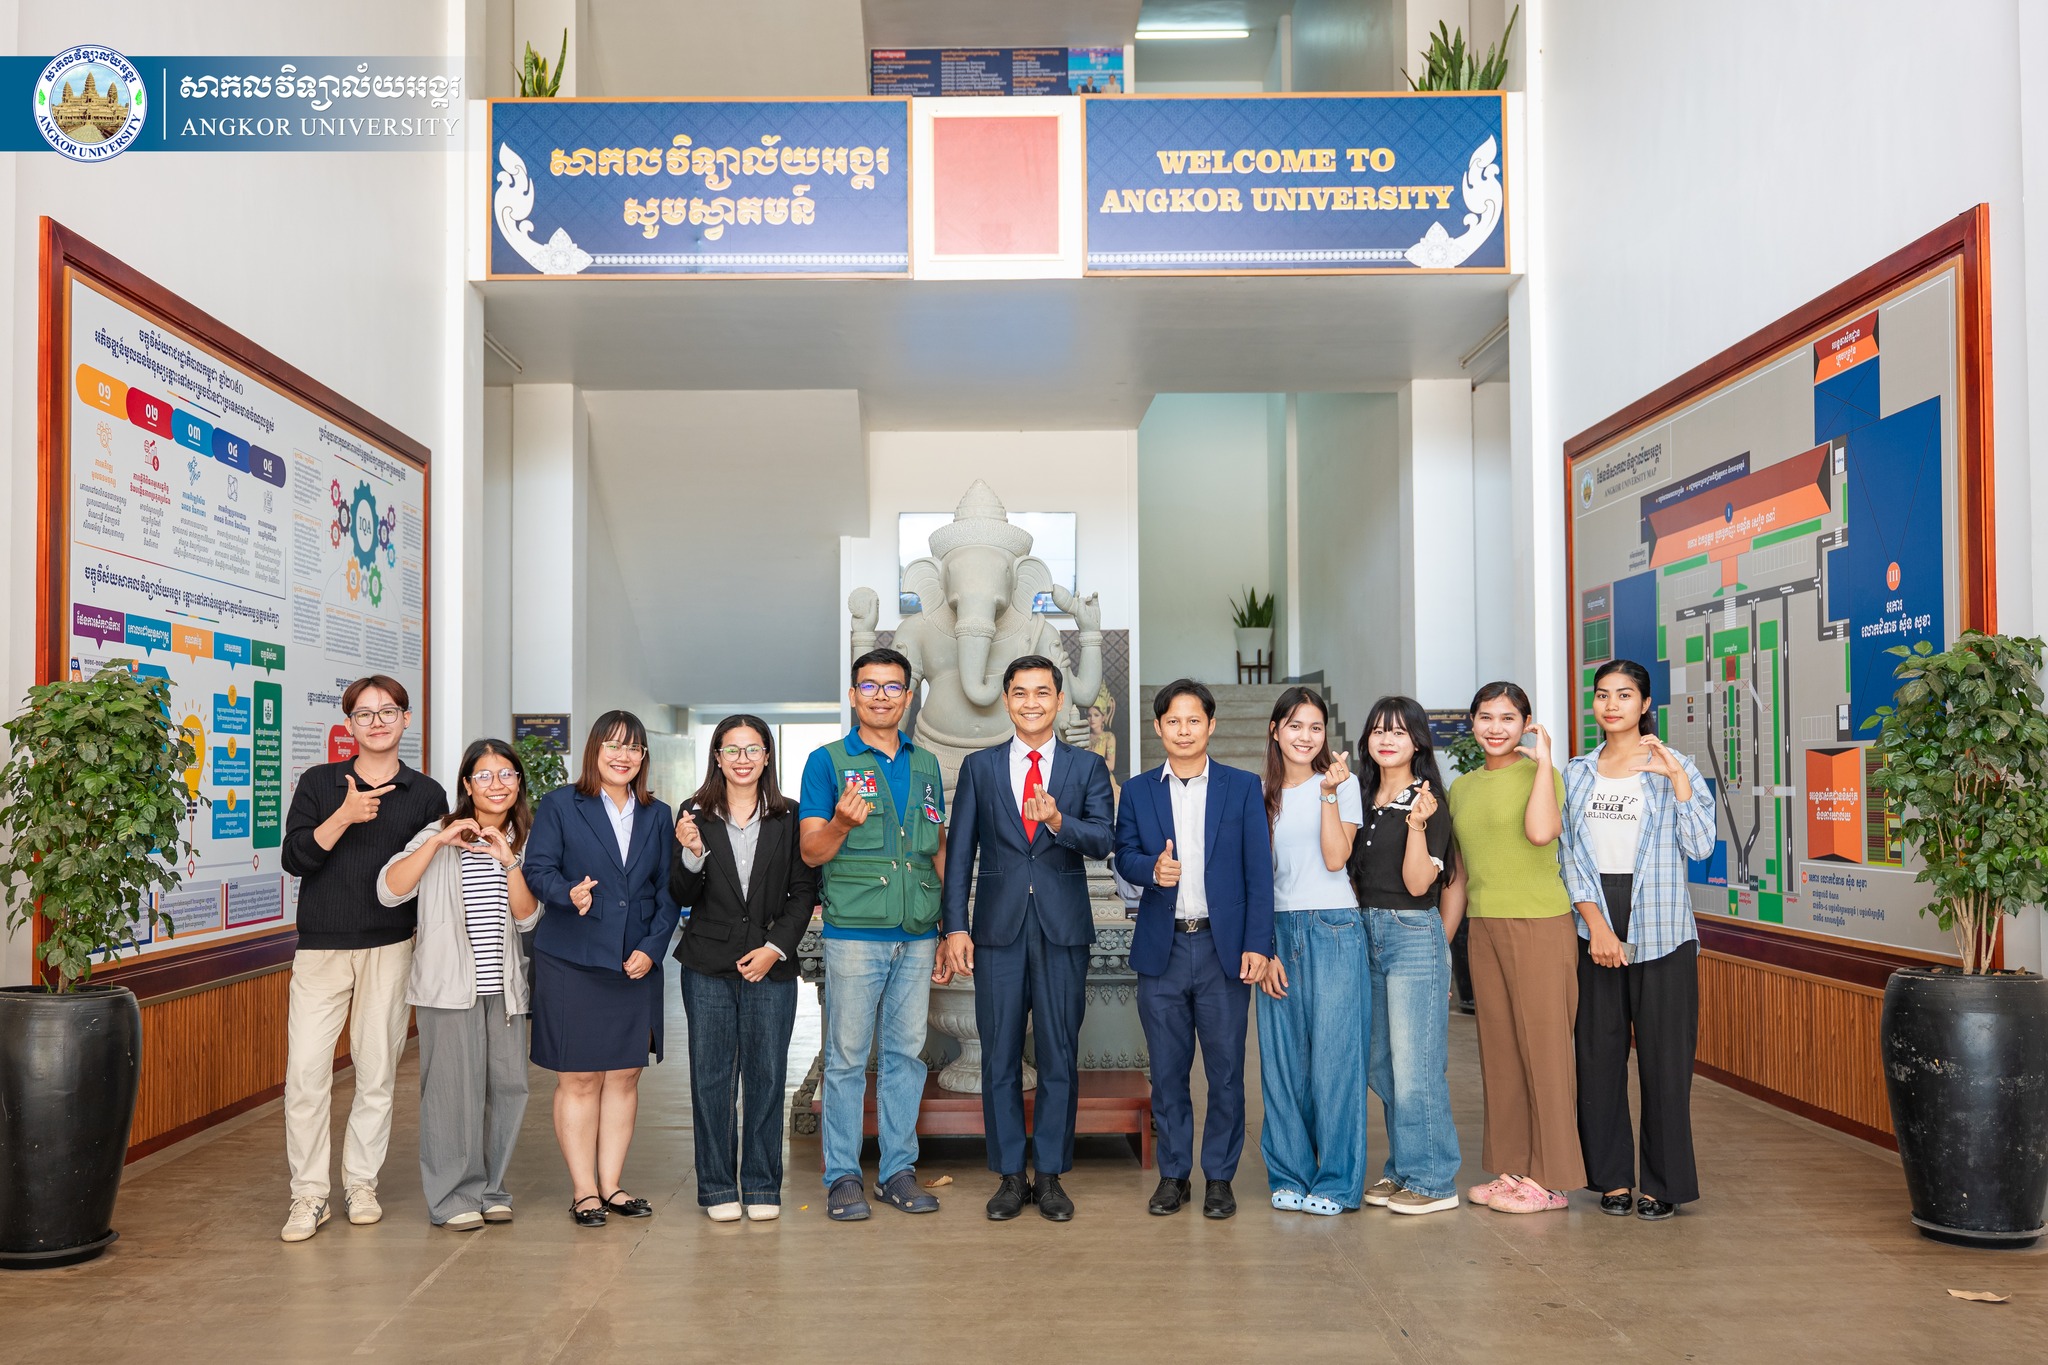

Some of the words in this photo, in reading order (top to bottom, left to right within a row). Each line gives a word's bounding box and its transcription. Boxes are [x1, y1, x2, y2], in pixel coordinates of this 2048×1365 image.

[550, 134, 889, 191] សាកលវិទ្យាល័យអង្គរ
[1156, 148, 1337, 175] WELCOME
[1346, 147, 1396, 172] TO
[623, 184, 816, 241] សូមស្វាគមន៍
[1100, 187, 1243, 213] ANGKOR
[1251, 185, 1455, 211] UNIVERSITY
[1621, 472, 1646, 491] UNIVERSITY
[1646, 466, 1657, 481] MAP
[359, 516, 371, 536] IQA
